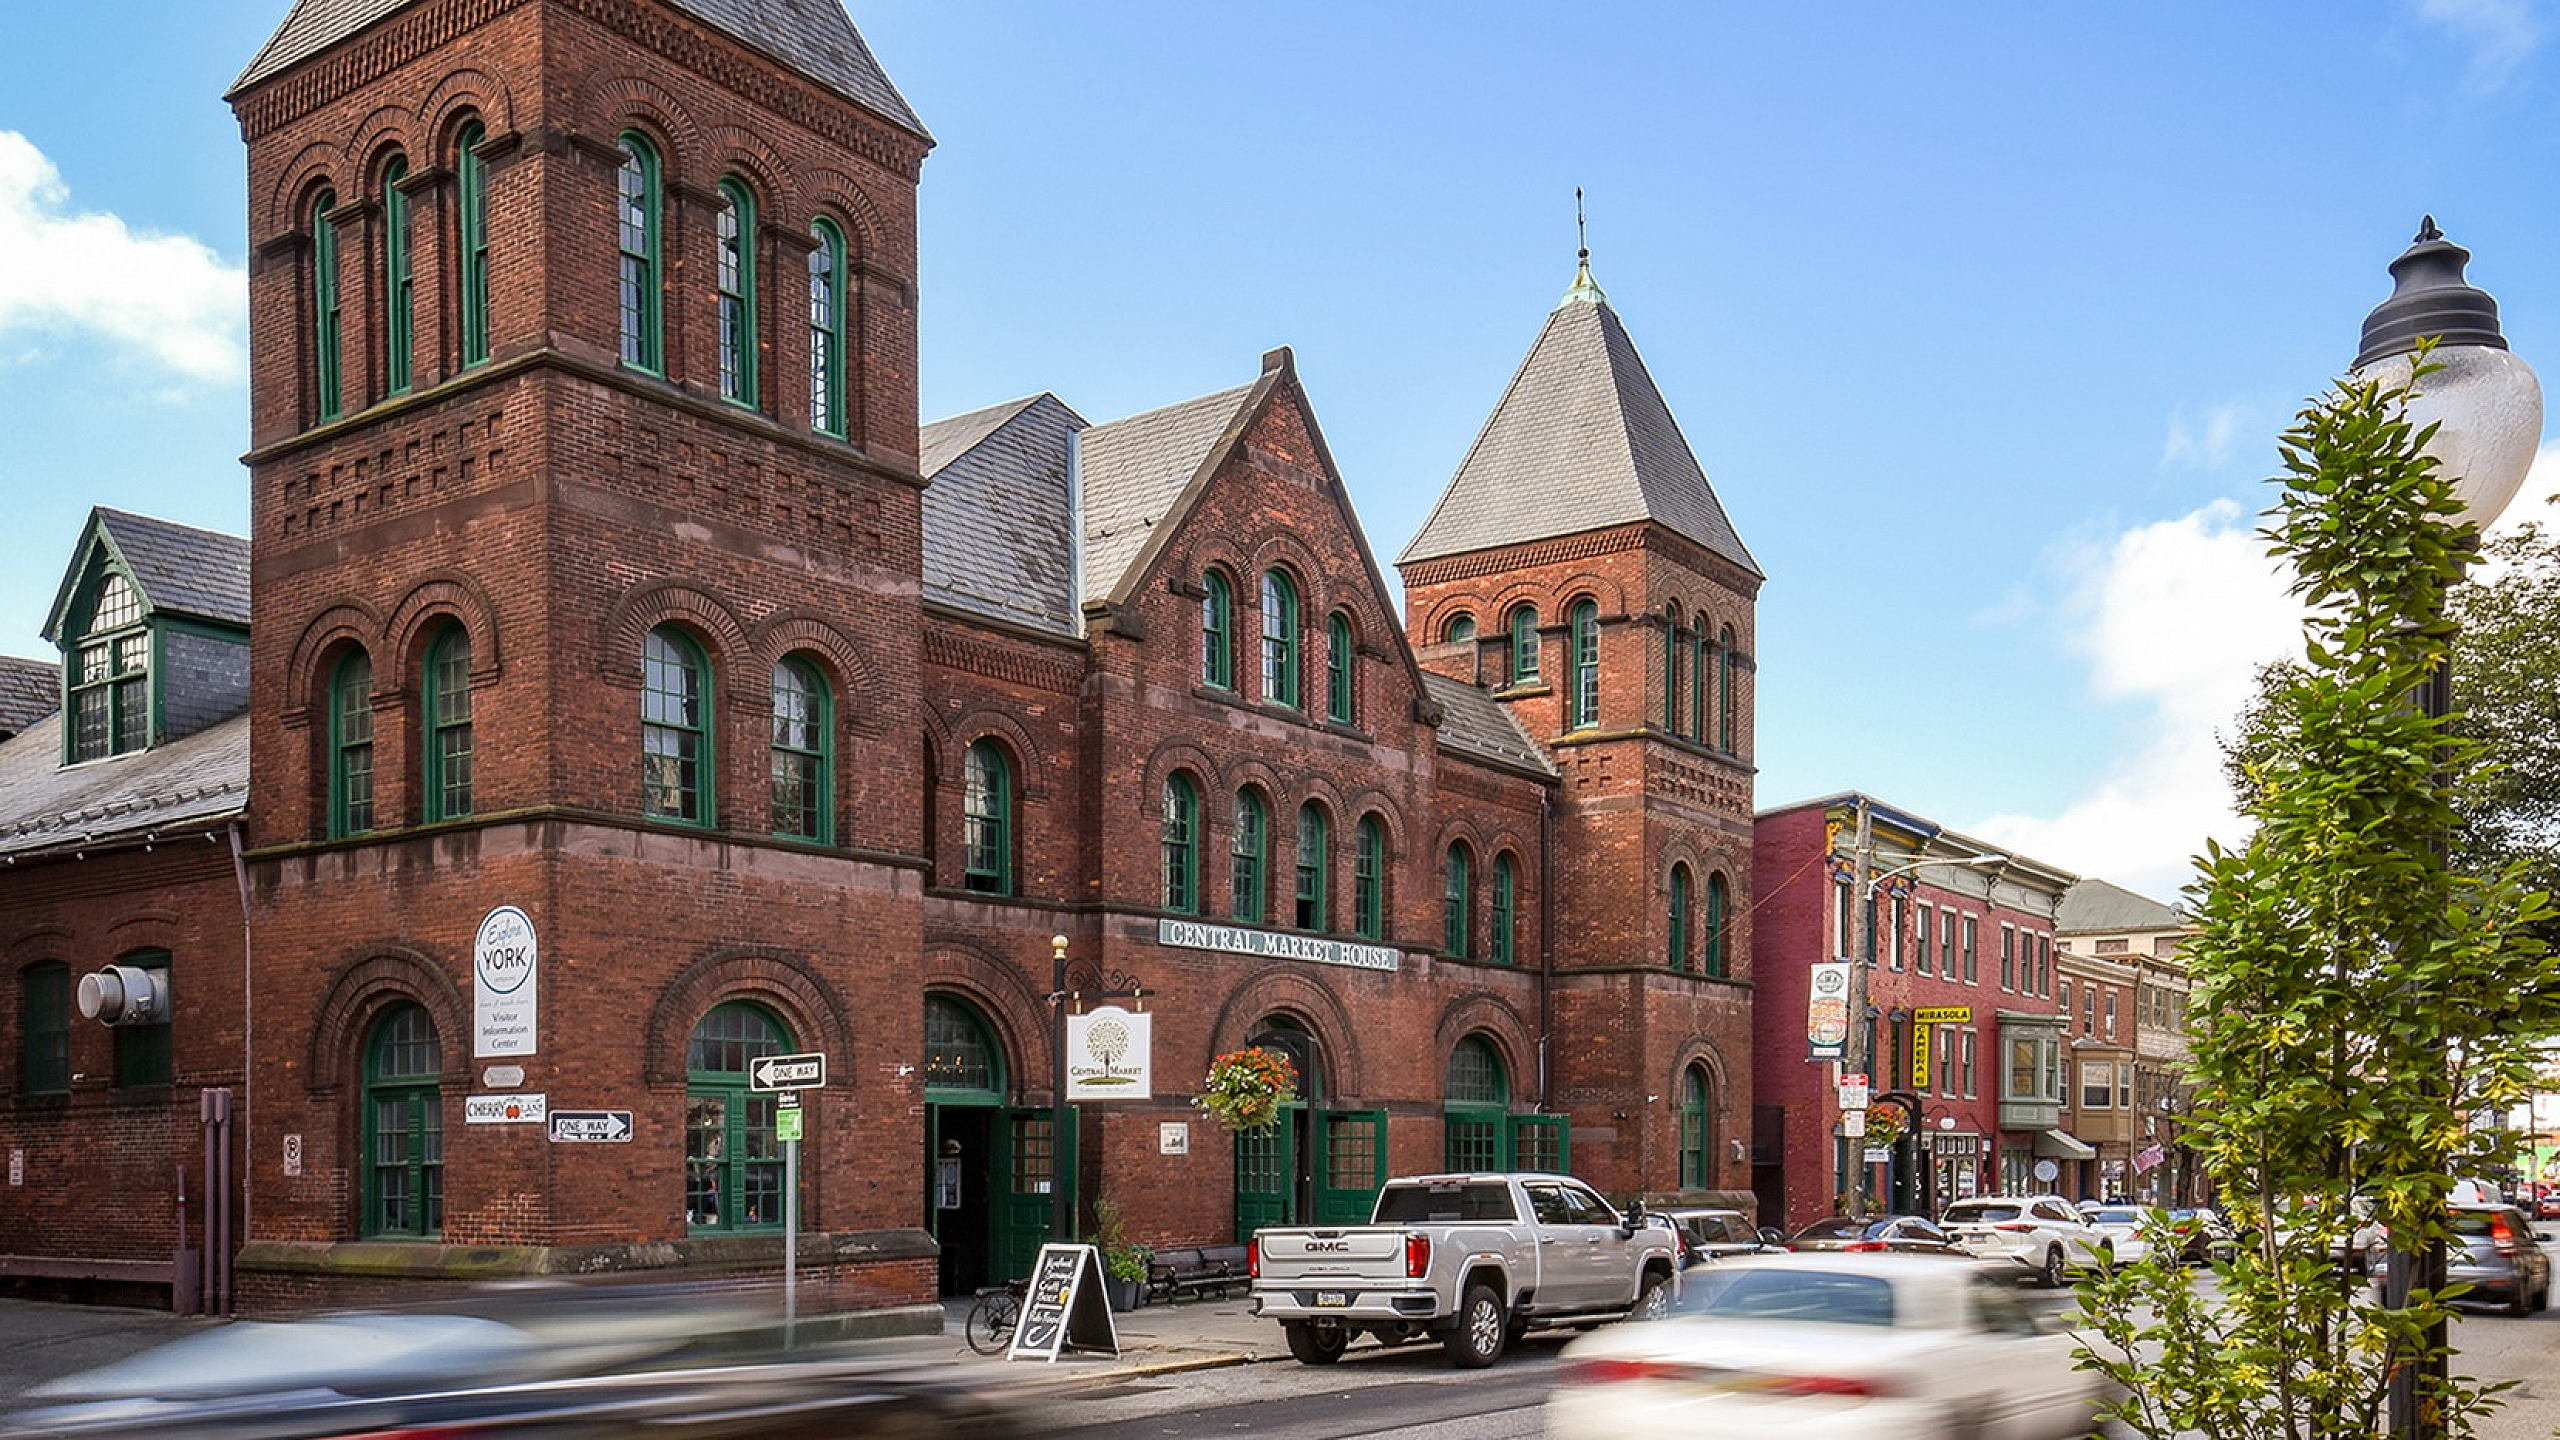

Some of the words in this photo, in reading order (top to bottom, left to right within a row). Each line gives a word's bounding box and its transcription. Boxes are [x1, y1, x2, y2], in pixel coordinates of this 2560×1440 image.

[1170, 922, 1256, 952] CENTRAL
[1263, 933, 1334, 961] MARKET
[1339, 943, 1390, 968] HOUSE
[482, 946, 528, 971] YORK
[492, 1012, 518, 1022] Visitor
[482, 1025, 528, 1036] Information
[491, 1039, 518, 1049] Center
[774, 1066, 793, 1080] ONE
[796, 1064, 815, 1077] WAY
[467, 1101, 505, 1117] CHERRY
[559, 1120, 582, 1132] ONE
[586, 1121, 609, 1132] WAY
[1305, 1242, 1349, 1252] GMC
